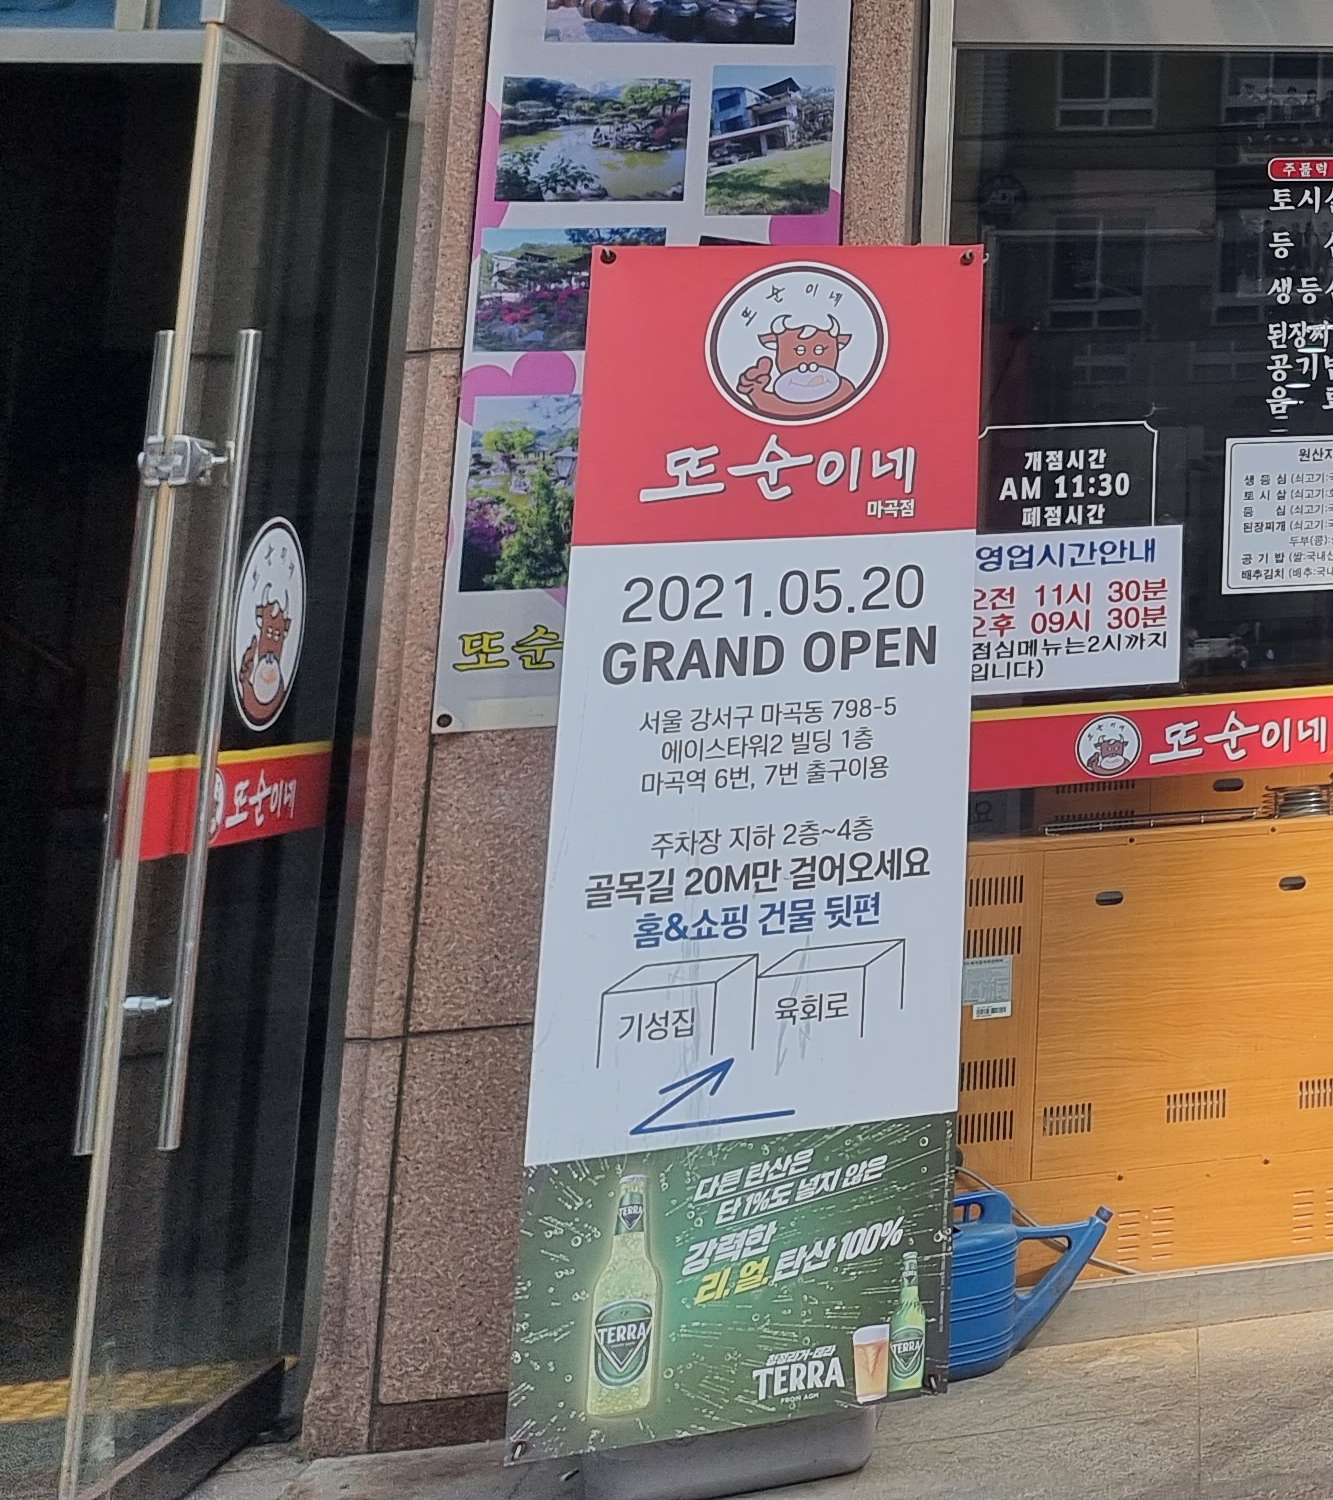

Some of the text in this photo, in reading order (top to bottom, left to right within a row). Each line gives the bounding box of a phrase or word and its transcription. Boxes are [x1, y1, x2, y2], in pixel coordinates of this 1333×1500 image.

[639, 434, 917, 503] 또순이네
[1024, 448, 1107, 472] 개점시간
[866, 498, 915, 518] 마곡점
[999, 472, 1131, 501] AM 11:30
[1021, 503, 1106, 527] 폐점시간
[975, 537, 1156, 572] 영업시간안내
[622, 564, 925, 624] 2021.05.20
[1034, 581, 1091, 607] 11시
[1107, 578, 1169, 603] 30분
[1030, 609, 1091, 635] 09시
[1106, 604, 1168, 629] 30분
[602, 625, 937, 685] GRAND OPEN
[639, 696, 897, 735] 서울 강서구 마곡동 798-5
[1149, 709, 1328, 764] 또순이네
[661, 726, 874, 763] 에이스타워2 빌딩 1층
[641, 755, 889, 796] 마곡역 6번, 7번 출구이용
[225, 768, 298, 830] 또순이네
[651, 816, 874, 859] 주차장 지하 2층~4층
[585, 846, 931, 909] 골목길 20M만 걸어오세요
[633, 892, 881, 949] 홈&쇼핑 건물 뒷편
[617, 992, 849, 1043] 기성집 육회로
[694, 1148, 815, 1201] 다른 탄산은
[741, 1181, 795, 1217] 1%도
[841, 1154, 889, 1188] 않은
[681, 1220, 778, 1276] 강력한
[836, 1216, 904, 1264] 100%
[598, 1321, 648, 1348] TERRA
[891, 1340, 923, 1354] TERRA
[752, 1357, 846, 1401] TERRA
